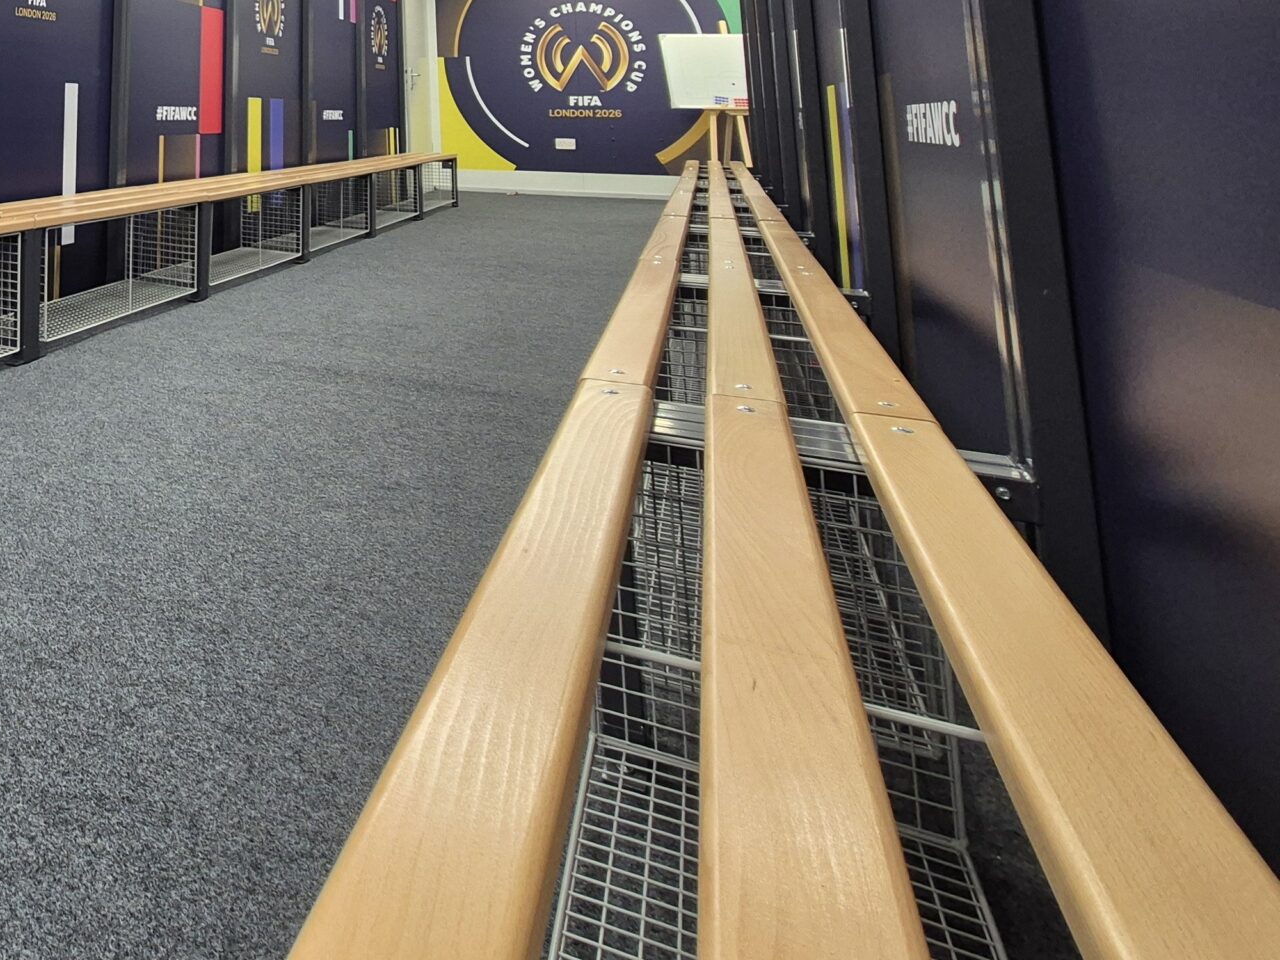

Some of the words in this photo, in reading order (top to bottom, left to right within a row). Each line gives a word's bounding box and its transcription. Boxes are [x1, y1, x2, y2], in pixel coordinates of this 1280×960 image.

[15, 6, 42, 19] LONDON
[41, 9, 57, 22] 2026
[520, 17, 546, 93] WOMEN'S
[549, 1, 647, 53] CHAMPIONS
[625, 60, 647, 93] CUP
[568, 95, 602, 107] FIFA
[156, 105, 198, 121] #FIFAWCC
[548, 108, 594, 119] LONDON
[594, 108, 622, 119] 2026
[906, 99, 960, 148] #FIFAWCC
